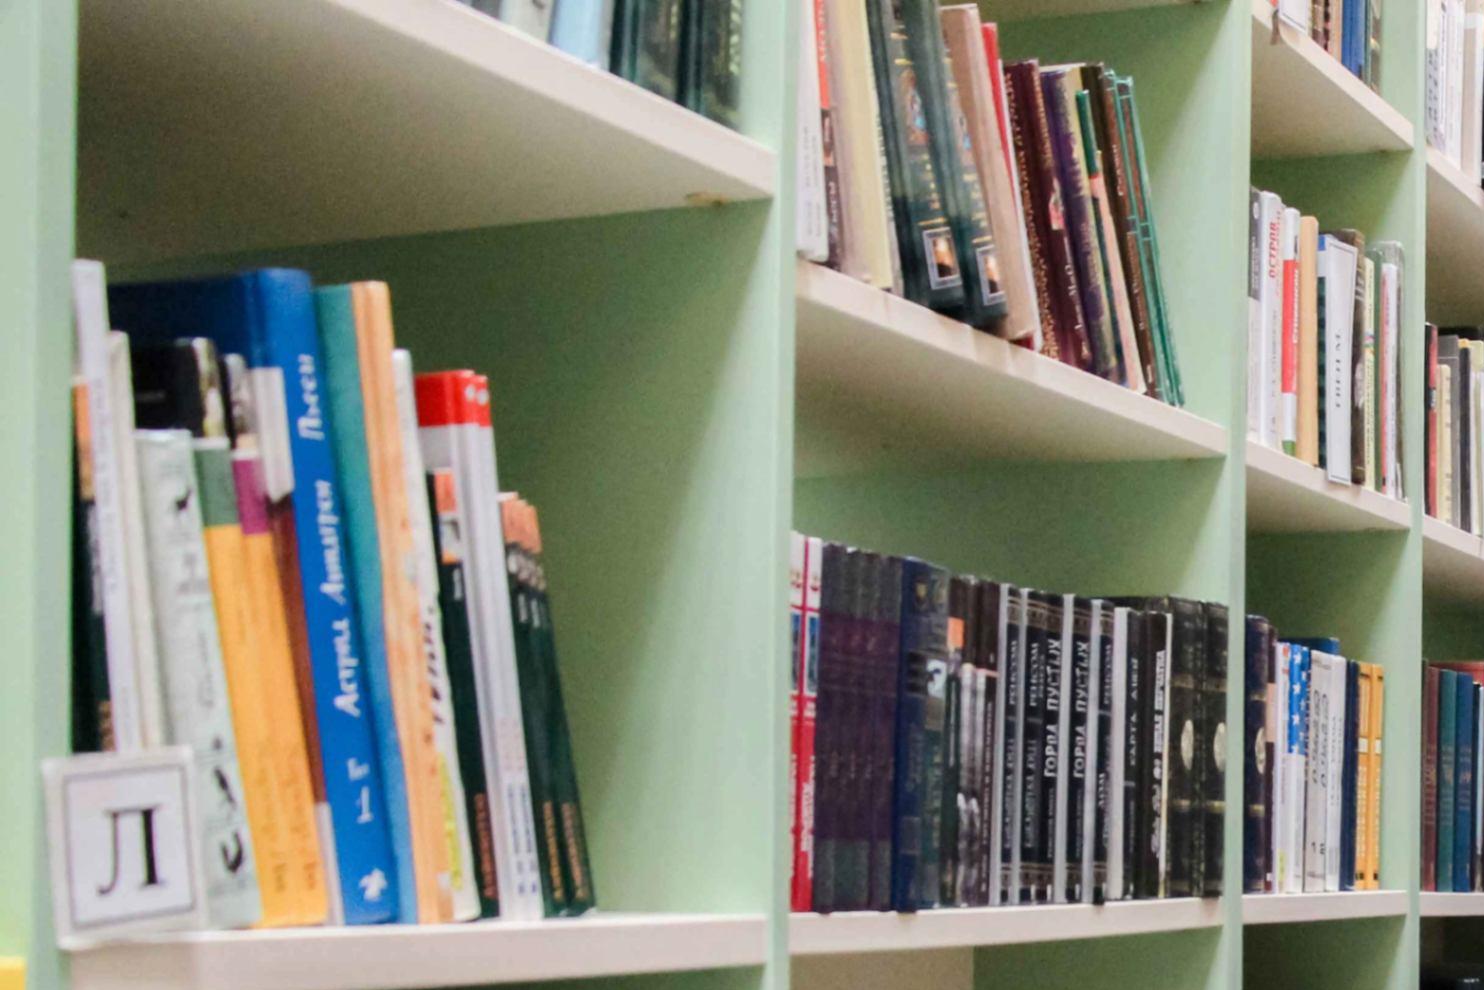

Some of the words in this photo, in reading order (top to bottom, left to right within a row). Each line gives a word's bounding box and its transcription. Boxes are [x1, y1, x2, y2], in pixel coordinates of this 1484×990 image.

[298, 352, 326, 441] Пьесы
[317, 477, 349, 605] Линдгрен
[332, 616, 361, 718] Астрид
[1045, 639, 1061, 712] ПУСТЫХ
[1075, 640, 1089, 713] ПУСТЫХ
[99, 804, 165, 895] Л
